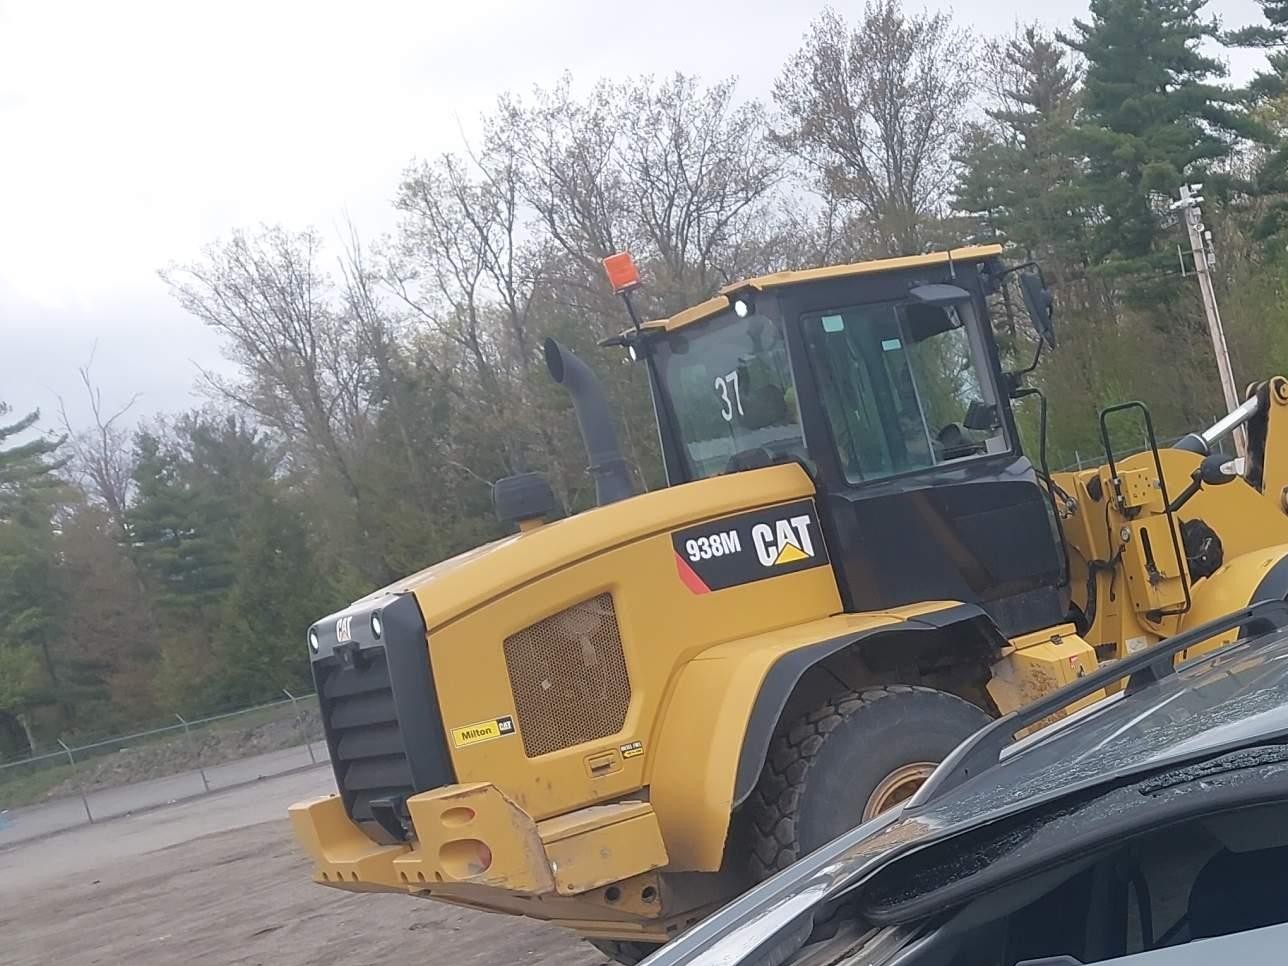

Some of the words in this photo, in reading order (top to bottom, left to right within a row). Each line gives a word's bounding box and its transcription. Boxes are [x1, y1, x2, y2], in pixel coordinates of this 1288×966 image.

[715, 370, 744, 421] 37
[685, 530, 742, 562] 938M
[751, 515, 815, 567] CAT
[461, 727, 493, 741] Milton
